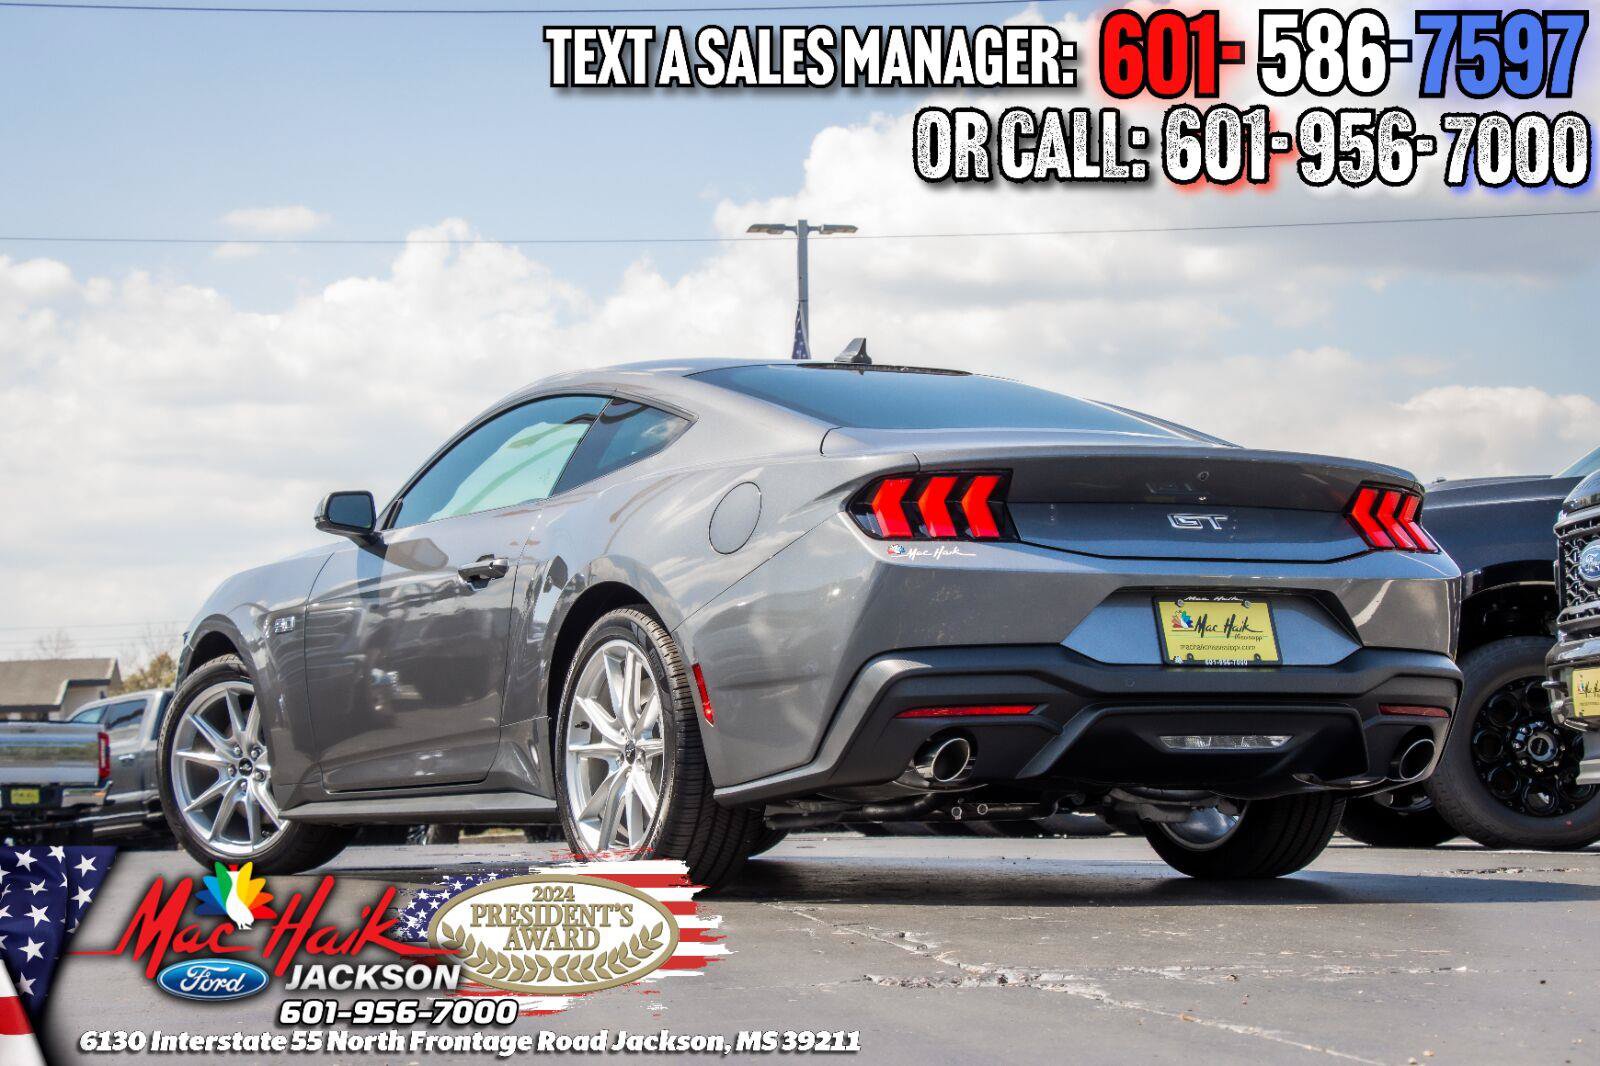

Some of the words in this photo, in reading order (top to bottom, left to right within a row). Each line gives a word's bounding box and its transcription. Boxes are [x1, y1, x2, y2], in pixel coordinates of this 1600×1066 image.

[1167, 513, 1229, 530] GT
[902, 547, 932, 560] Mac
[933, 546, 970, 560] Haik
[1191, 614, 1220, 638] Mac
[1223, 614, 1259, 638] Haik
